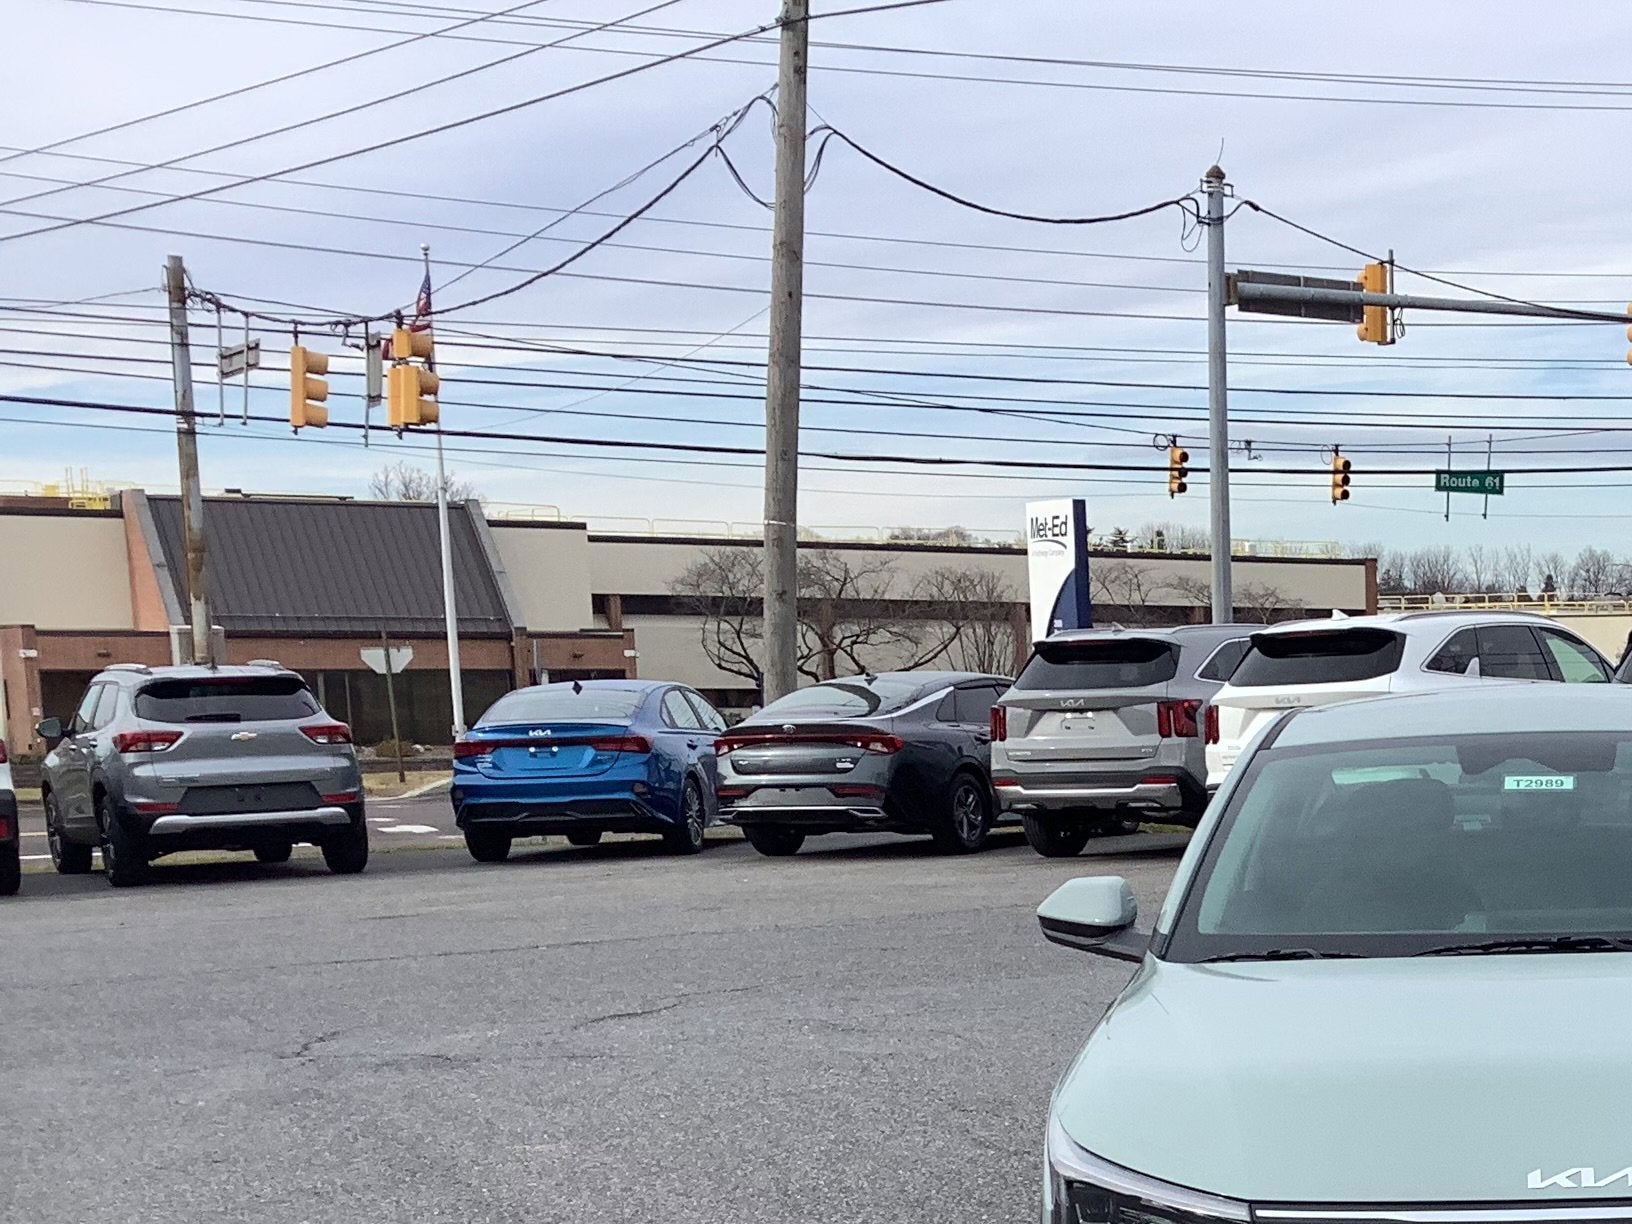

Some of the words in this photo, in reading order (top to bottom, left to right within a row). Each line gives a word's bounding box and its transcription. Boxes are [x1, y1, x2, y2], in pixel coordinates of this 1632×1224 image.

[1440, 473, 1480, 487] Route
[1485, 476, 1500, 490] 61
[1030, 514, 1068, 539] Met-Ed
[528, 729, 551, 737] KIA
[1513, 779, 1565, 788] T2989
